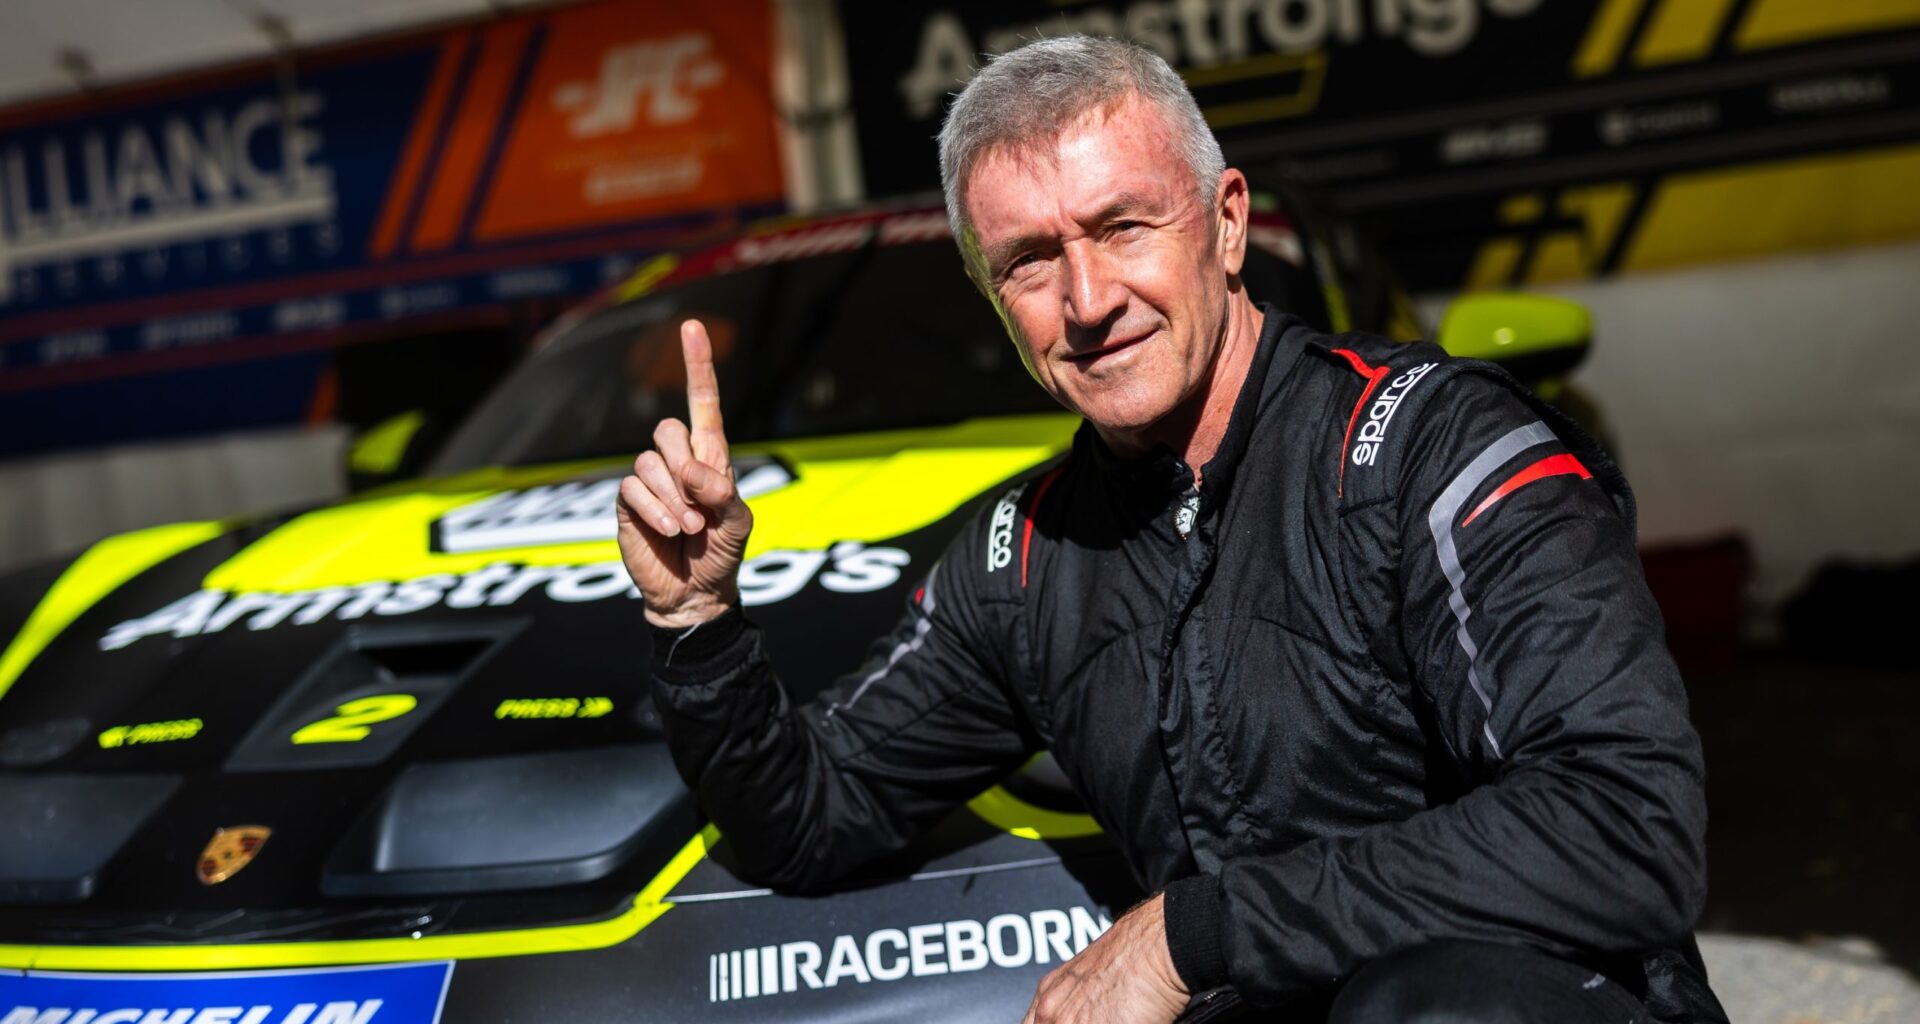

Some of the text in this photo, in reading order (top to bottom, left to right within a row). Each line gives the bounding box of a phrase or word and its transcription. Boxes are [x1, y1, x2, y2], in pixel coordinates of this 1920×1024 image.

[900, 0, 1542, 118] Astrong
[1352, 363, 1430, 466] sparco
[992, 484, 1027, 568] parco
[97, 540, 911, 651] Armstrog's
[291, 694, 418, 744] 2
[494, 698, 580, 719] PRESS
[781, 906, 1114, 993] RACEBORN
